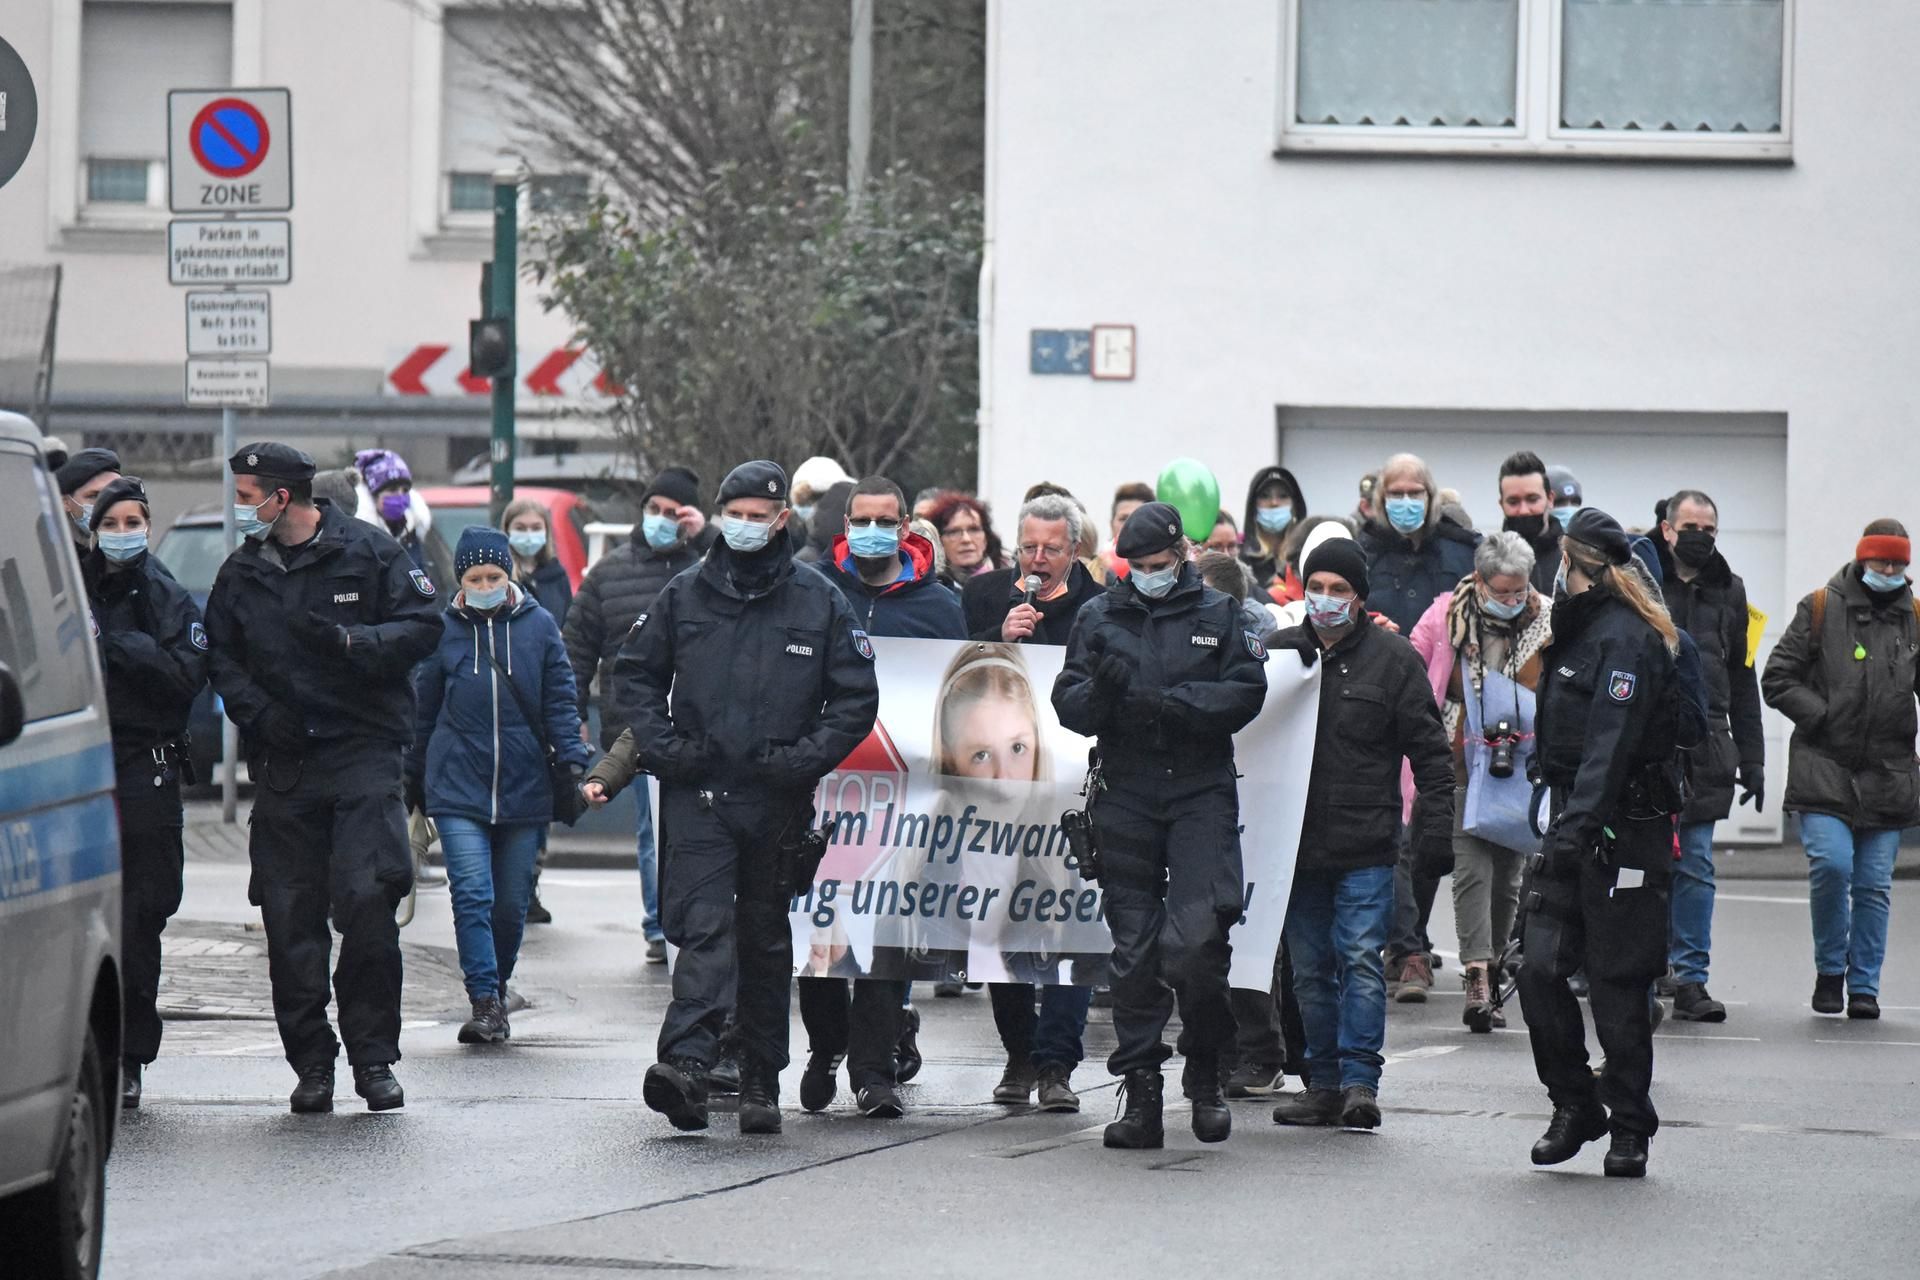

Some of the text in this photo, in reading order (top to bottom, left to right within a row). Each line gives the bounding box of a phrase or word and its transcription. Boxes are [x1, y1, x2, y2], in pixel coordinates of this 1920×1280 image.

[201, 184, 261, 205] ZONE
[200, 226, 259, 241] Parken in
[175, 244, 285, 264] gekennzeichneten
[181, 262, 279, 278] Flächen erlaubt
[333, 592, 359, 603] POLIZEI
[785, 644, 813, 656] POLIZEI
[1191, 635, 1218, 647] POLIZEI
[819, 772, 895, 832] TOP
[879, 802, 1080, 871] Impfzwan
[851, 879, 1000, 922] unserer
[1008, 879, 1105, 923] Gese
